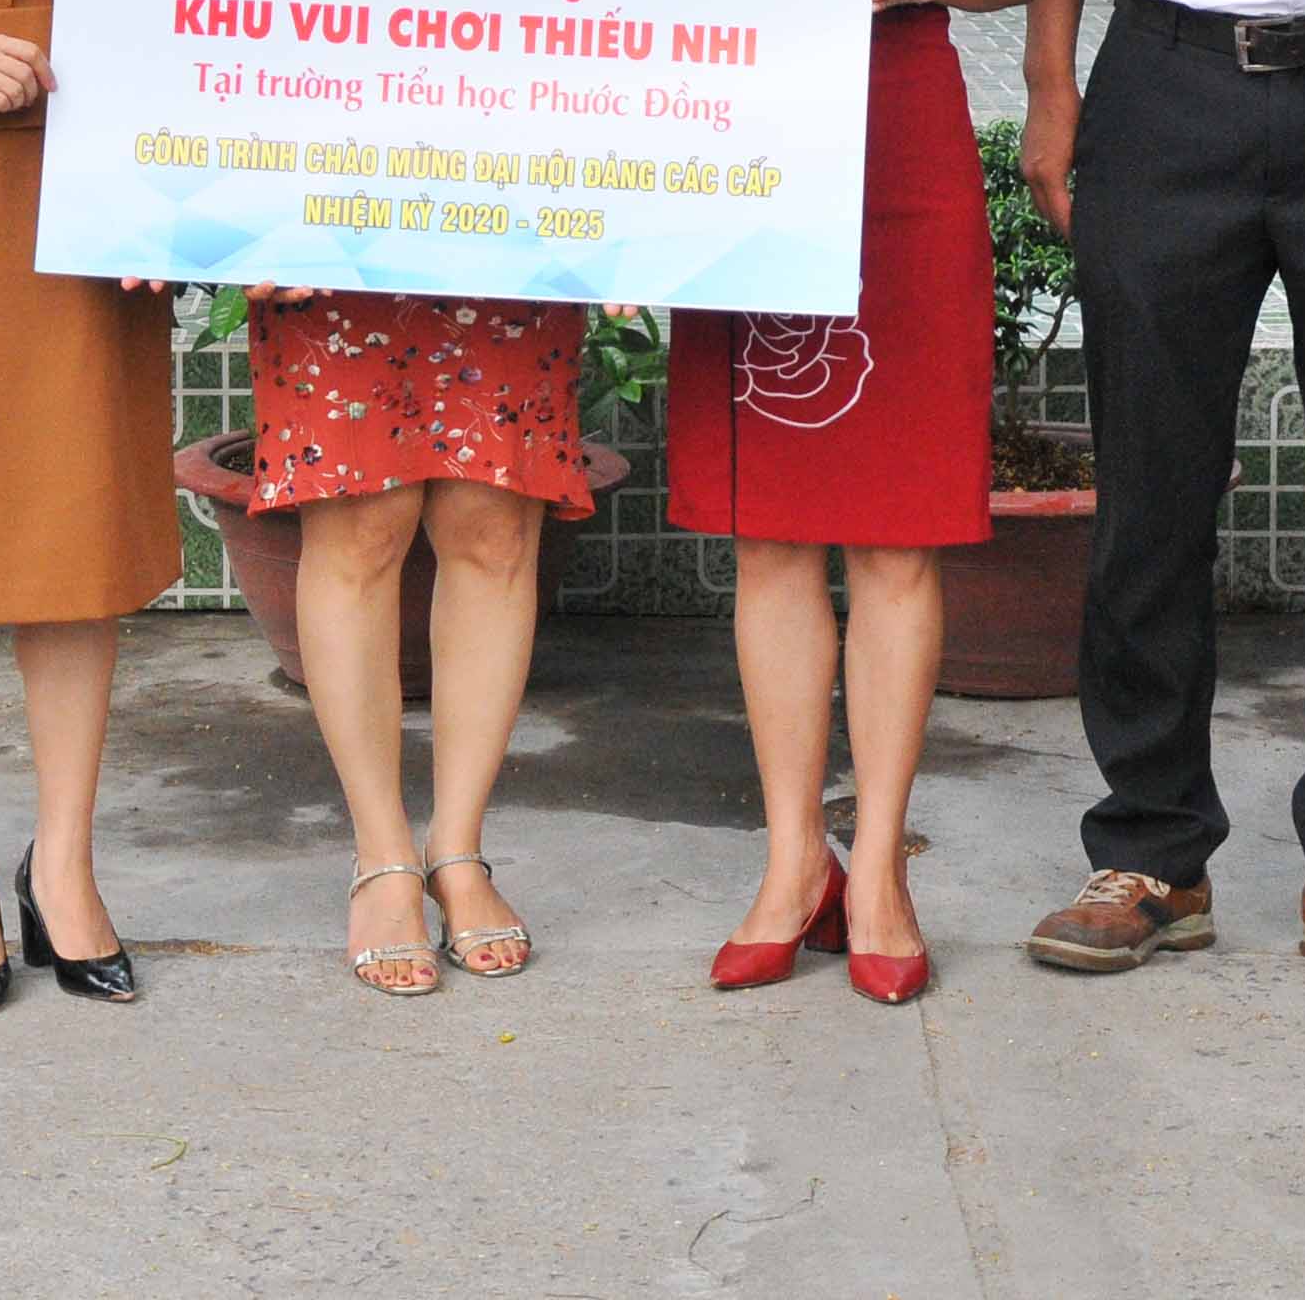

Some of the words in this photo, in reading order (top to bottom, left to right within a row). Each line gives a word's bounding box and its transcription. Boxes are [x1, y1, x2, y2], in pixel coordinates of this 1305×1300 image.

[289, 2, 370, 44] VUI
[387, 8, 501, 52] CHƠI
[519, 6, 653, 61] THIẾU
[671, 23, 757, 67] NHI
[193, 62, 243, 103] Tại
[256, 67, 364, 112] trường
[377, 66, 444, 106] Tiểu
[457, 75, 516, 117] học
[529, 79, 629, 117] Phước
[644, 76, 732, 132] Đồng
[134, 126, 209, 168] CÔNG
[216, 132, 298, 172] TRÌNH
[304, 136, 379, 178] CHÀO
[386, 140, 467, 182] MỪNG
[474, 151, 521, 191] ĐẠI
[527, 148, 576, 194] HỘI
[582, 150, 656, 192] ĐẢNG
[664, 155, 719, 195] CÁC
[727, 156, 782, 198] CẤP
[303, 190, 392, 235] NHIỆM
[400, 192, 435, 231] KỲ
[440, 203, 509, 235] 2020
[516, 218, 530, 229] -
[536, 207, 605, 241] 2025
